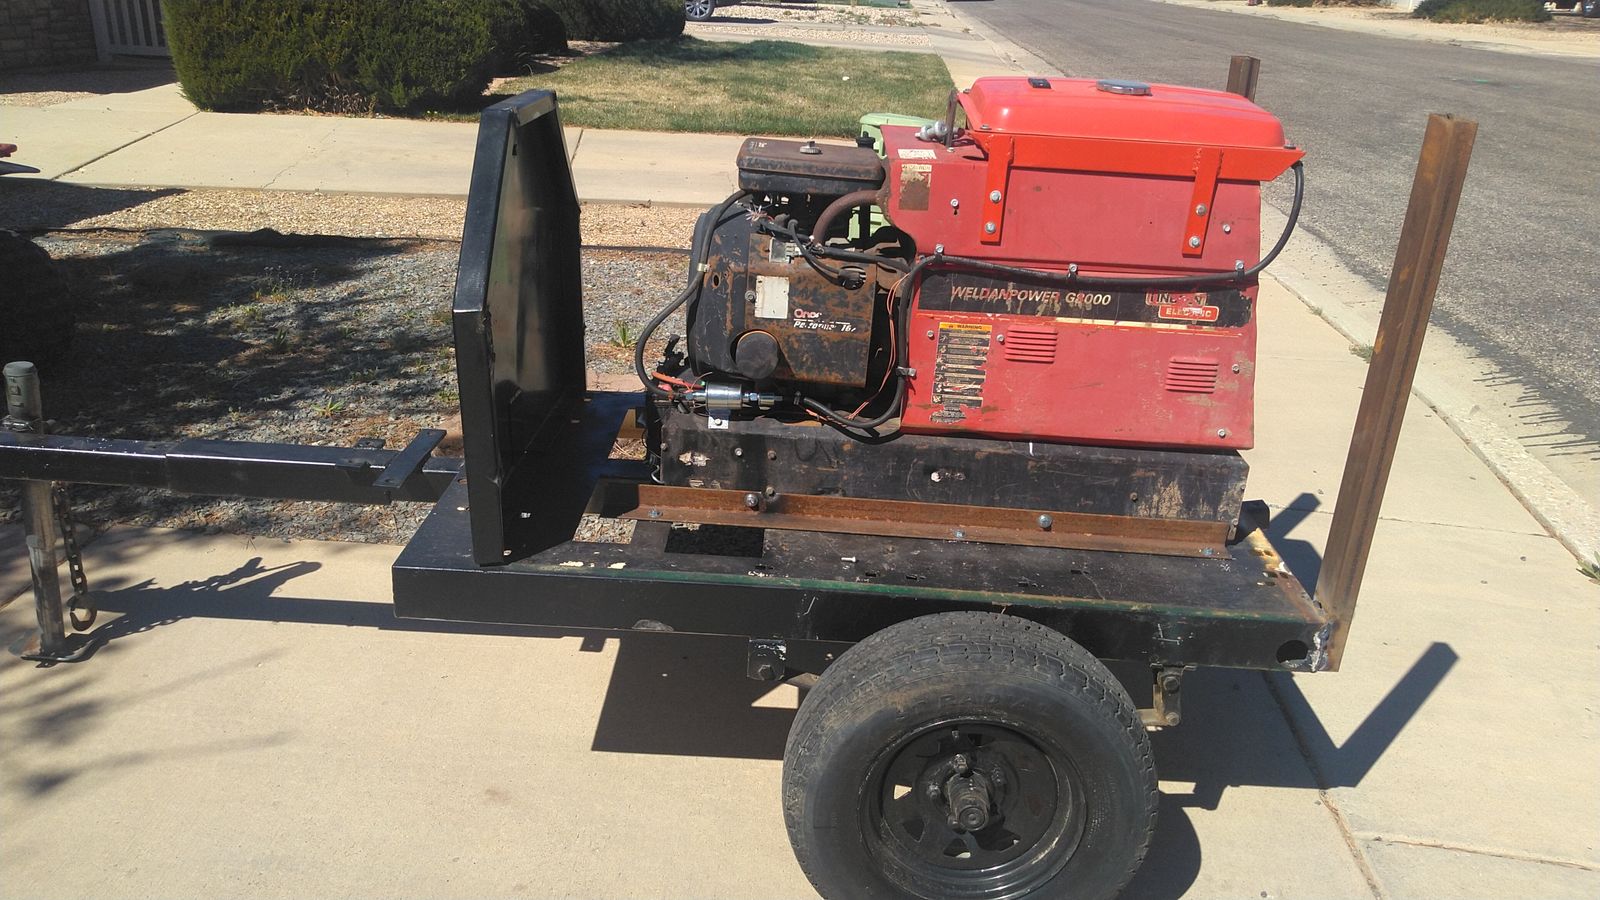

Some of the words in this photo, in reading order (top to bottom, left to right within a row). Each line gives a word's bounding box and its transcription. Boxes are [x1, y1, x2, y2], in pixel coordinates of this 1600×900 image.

[951, 286, 1060, 303] WELDANPOWER
[1065, 292, 1111, 306] G8000
[1165, 307, 1212, 318] ELECIC
